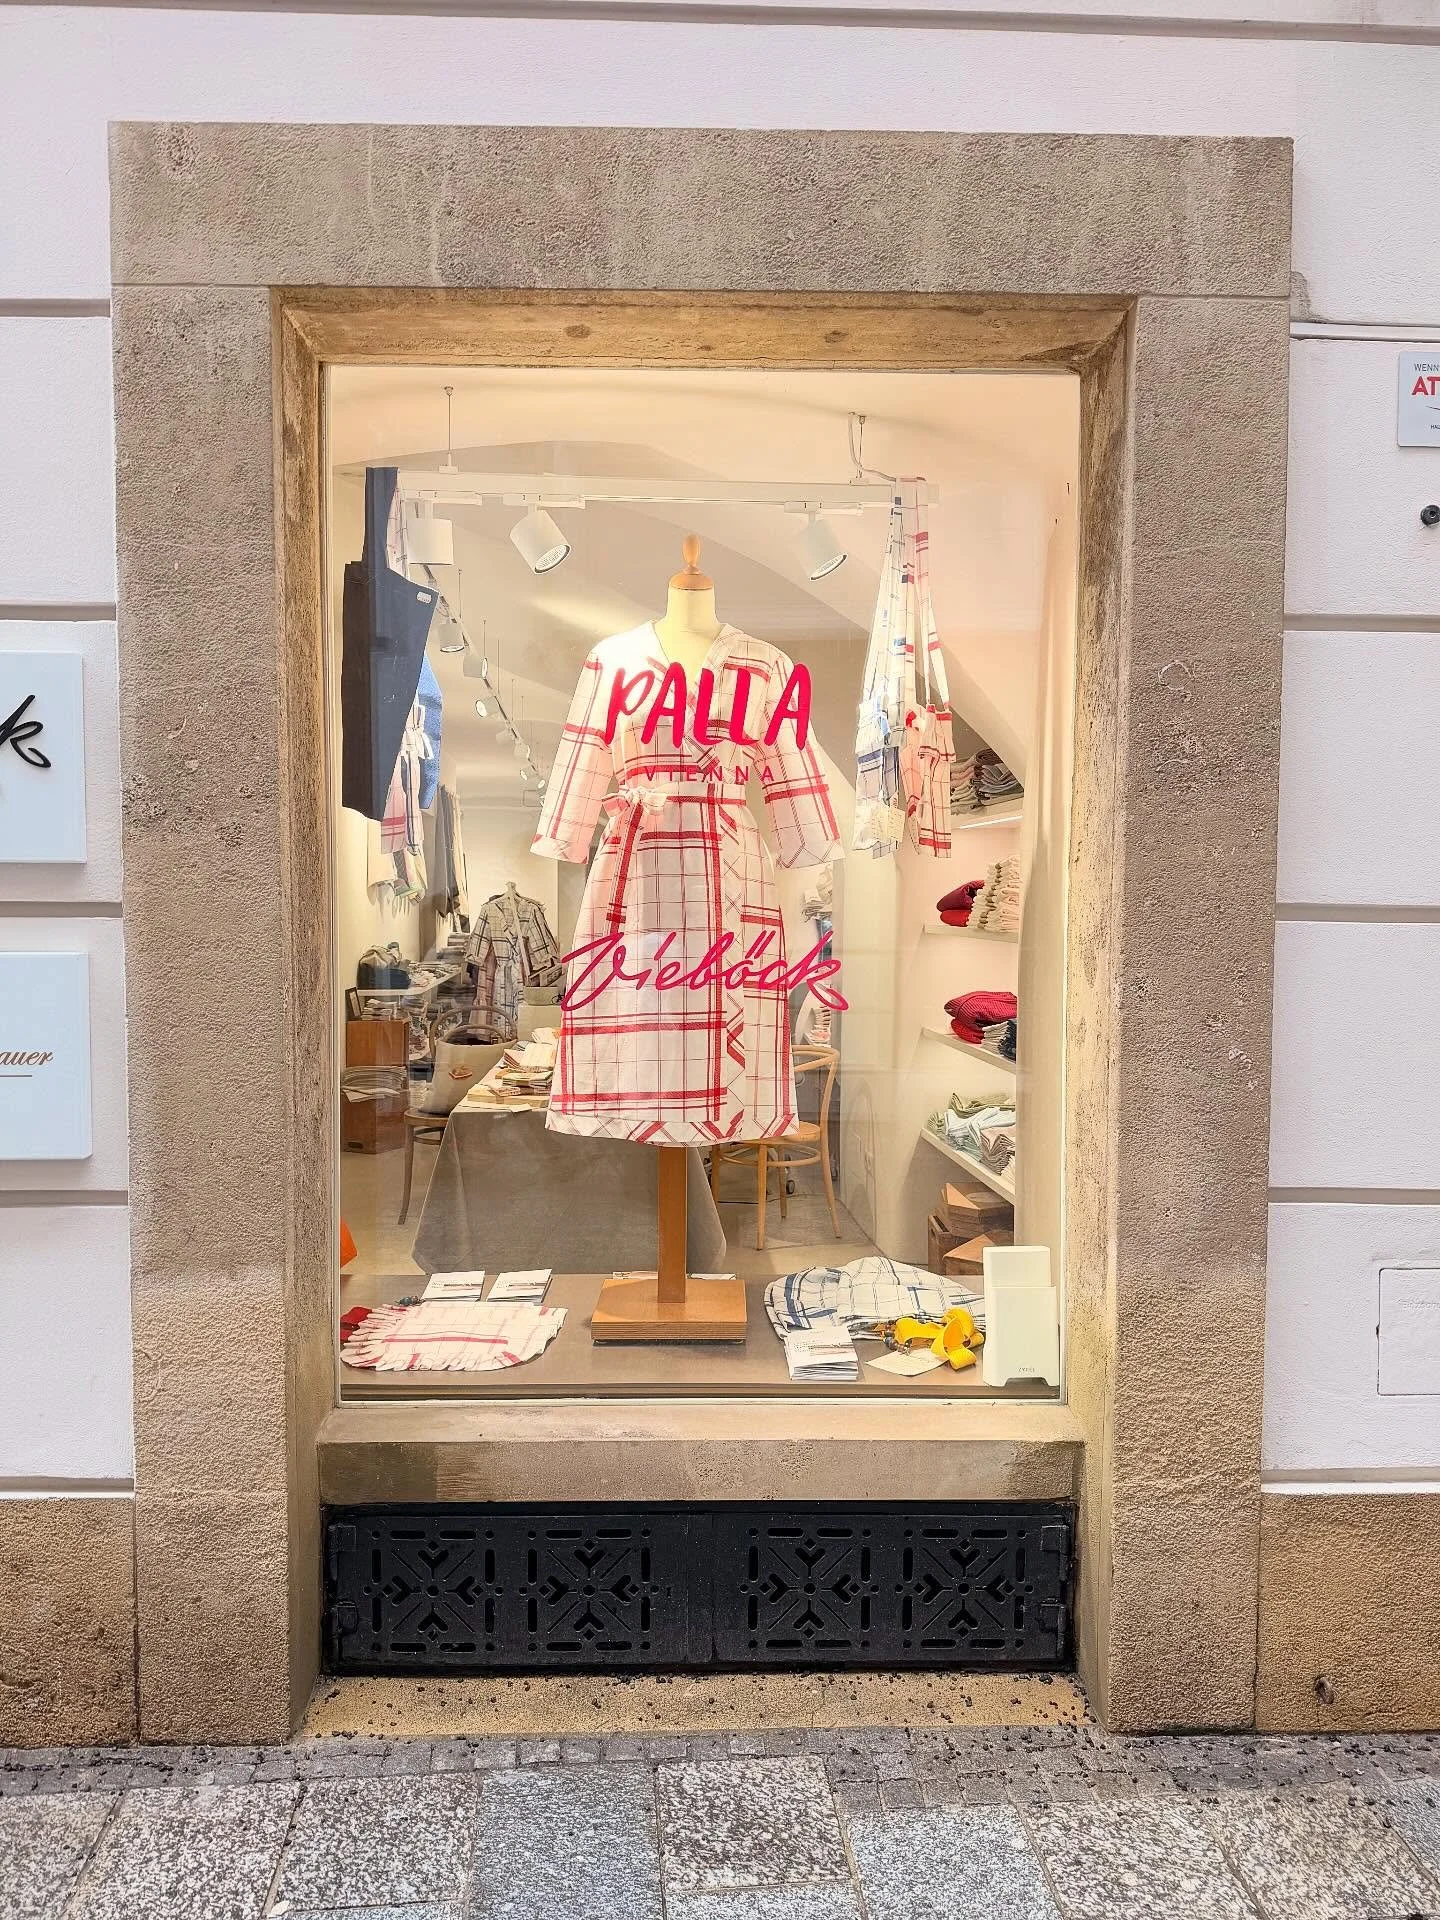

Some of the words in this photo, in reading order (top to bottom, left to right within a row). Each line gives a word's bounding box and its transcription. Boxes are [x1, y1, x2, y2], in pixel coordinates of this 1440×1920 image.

[604, 661, 812, 750] PALLA
[643, 764, 776, 783] VIENNA
[560, 931, 850, 1012] Vieböck
